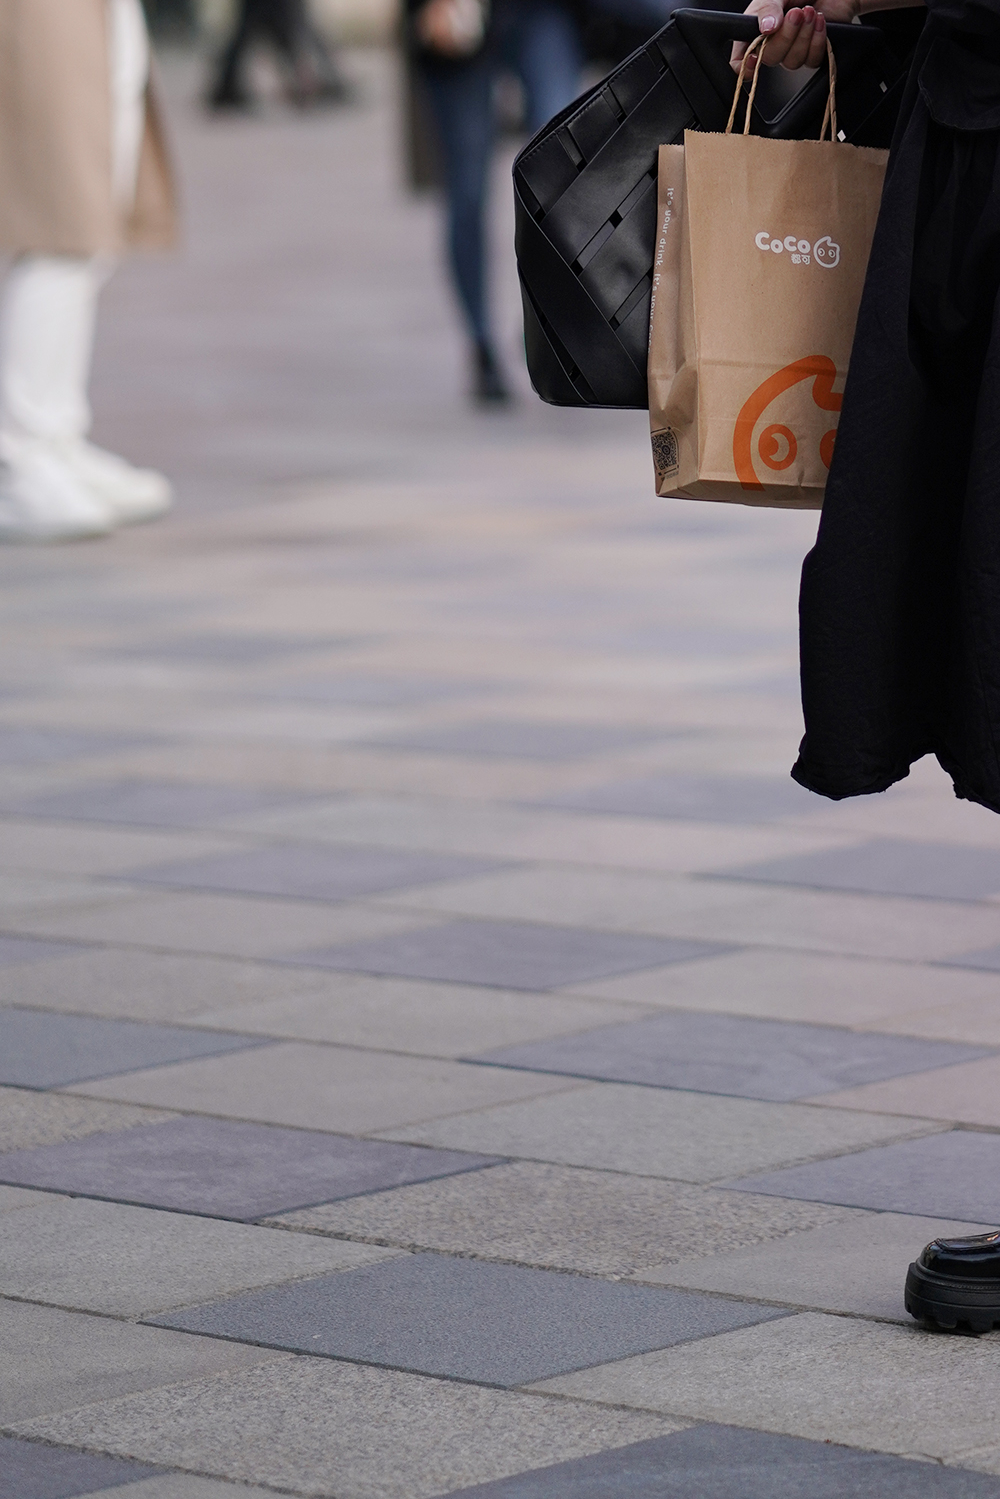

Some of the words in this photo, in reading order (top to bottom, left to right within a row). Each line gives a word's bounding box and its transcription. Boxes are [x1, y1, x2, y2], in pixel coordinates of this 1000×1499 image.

[662, 209, 672, 234] your
[655, 238, 667, 270] drink.
[755, 231, 811, 254] CoCo
